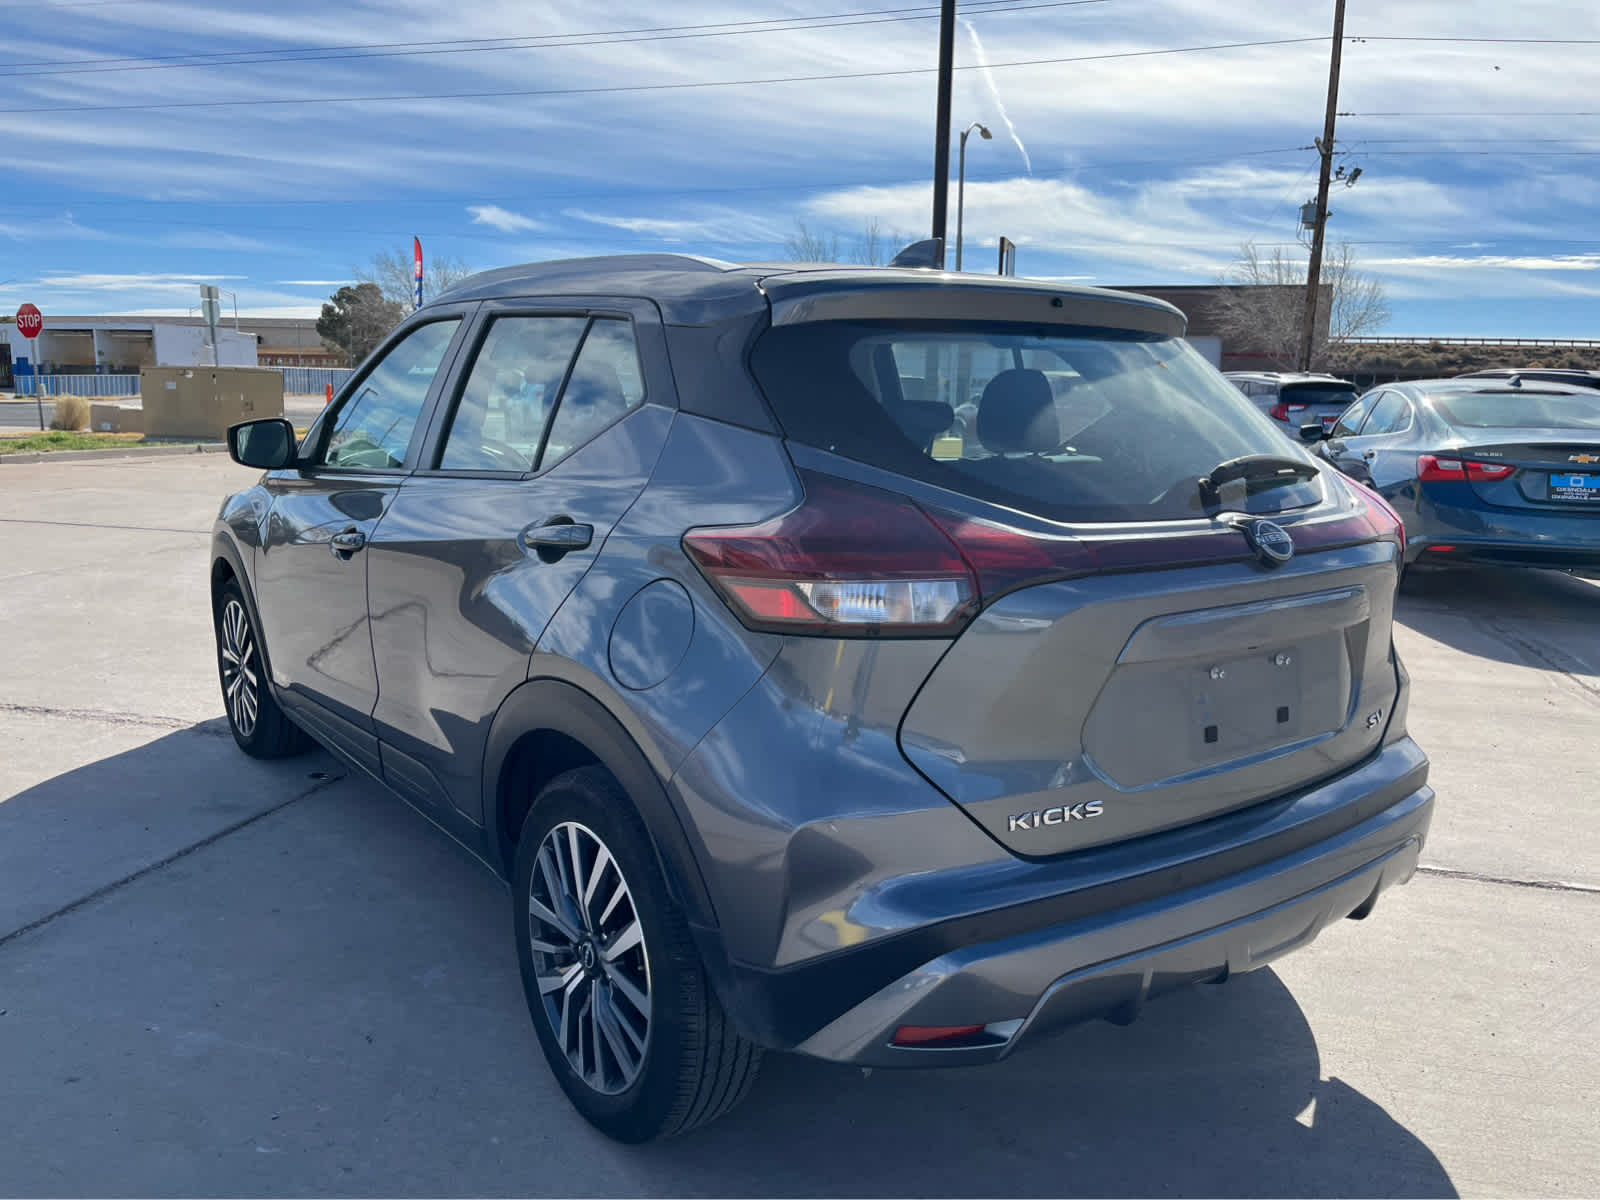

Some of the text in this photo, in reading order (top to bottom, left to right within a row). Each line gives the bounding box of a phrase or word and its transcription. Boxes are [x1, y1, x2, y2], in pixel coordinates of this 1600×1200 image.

[17, 313, 41, 328] STOP
[1366, 708, 1384, 729] SV
[1008, 800, 1104, 832] KICKS
